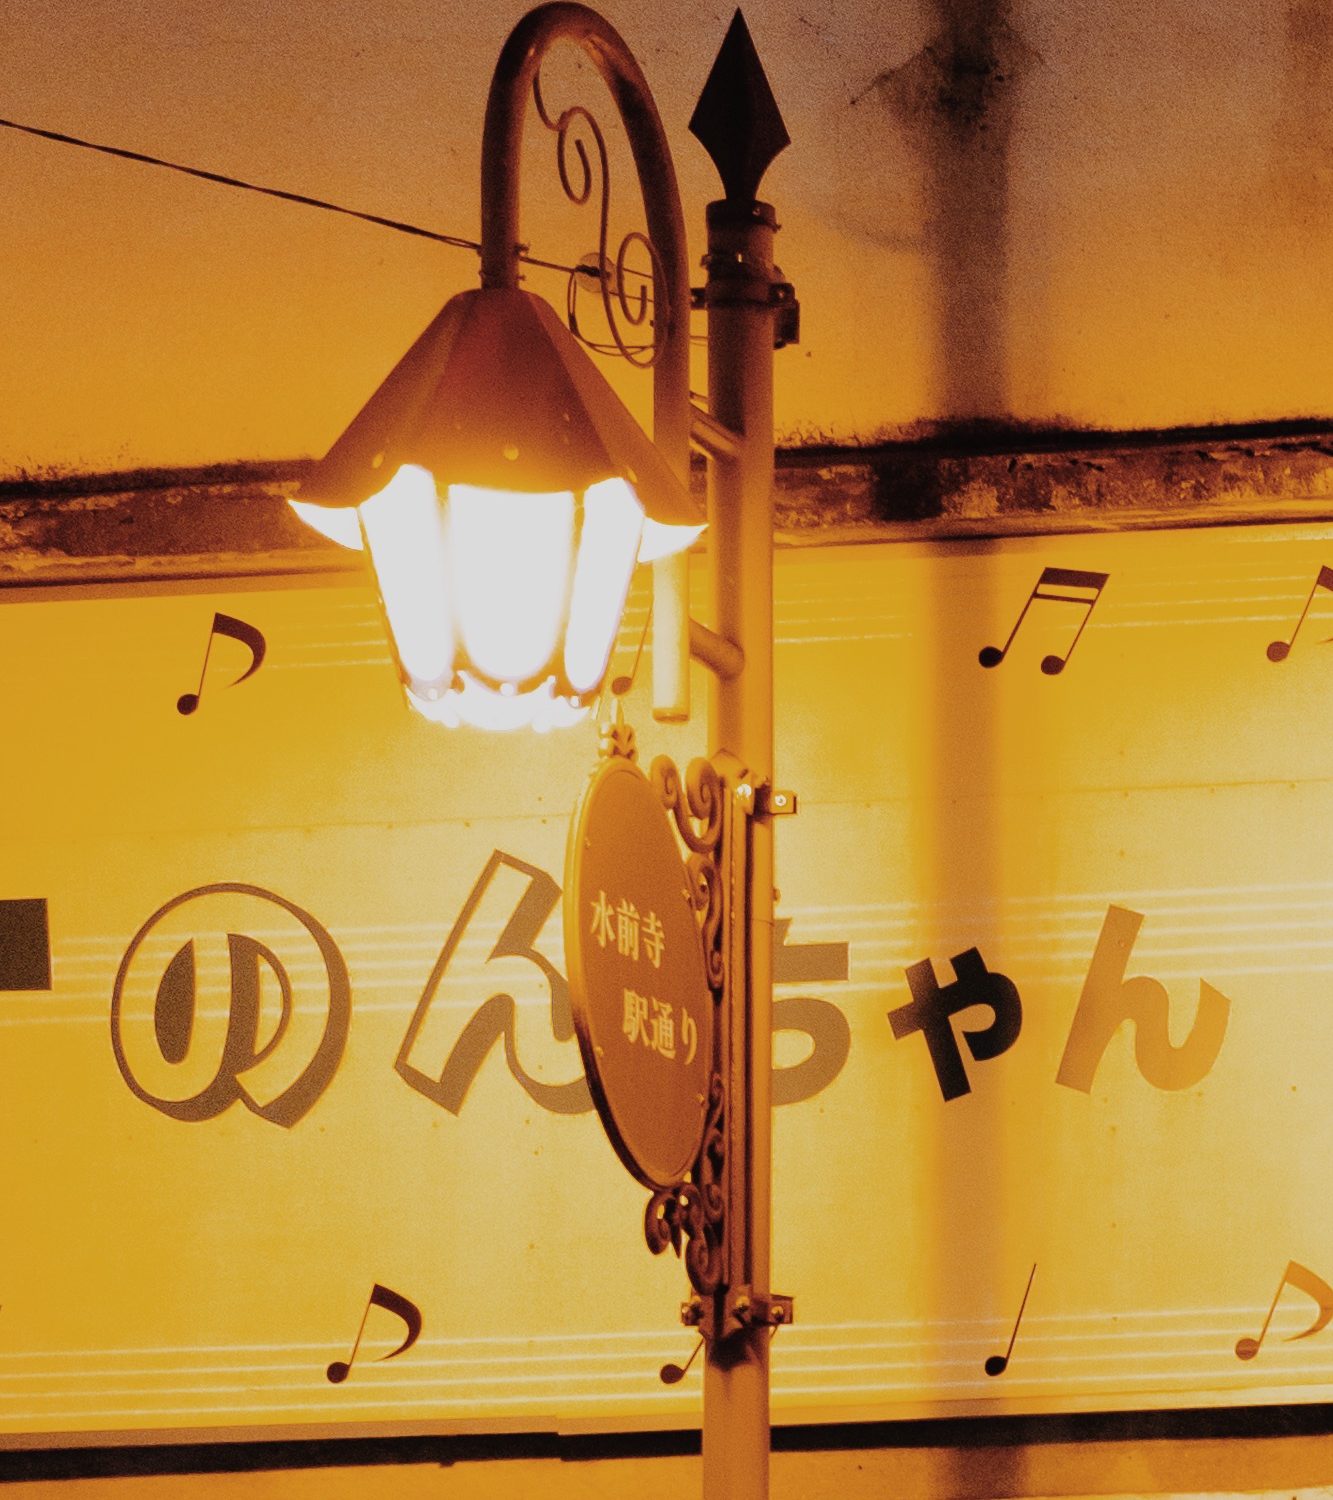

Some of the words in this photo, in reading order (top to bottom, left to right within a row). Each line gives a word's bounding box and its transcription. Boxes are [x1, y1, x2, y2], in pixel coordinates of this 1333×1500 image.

[590, 889, 665, 969] 水前寺
[0, 849, 1232, 1129] のんちゃん
[622, 987, 697, 1066] 駅通り
